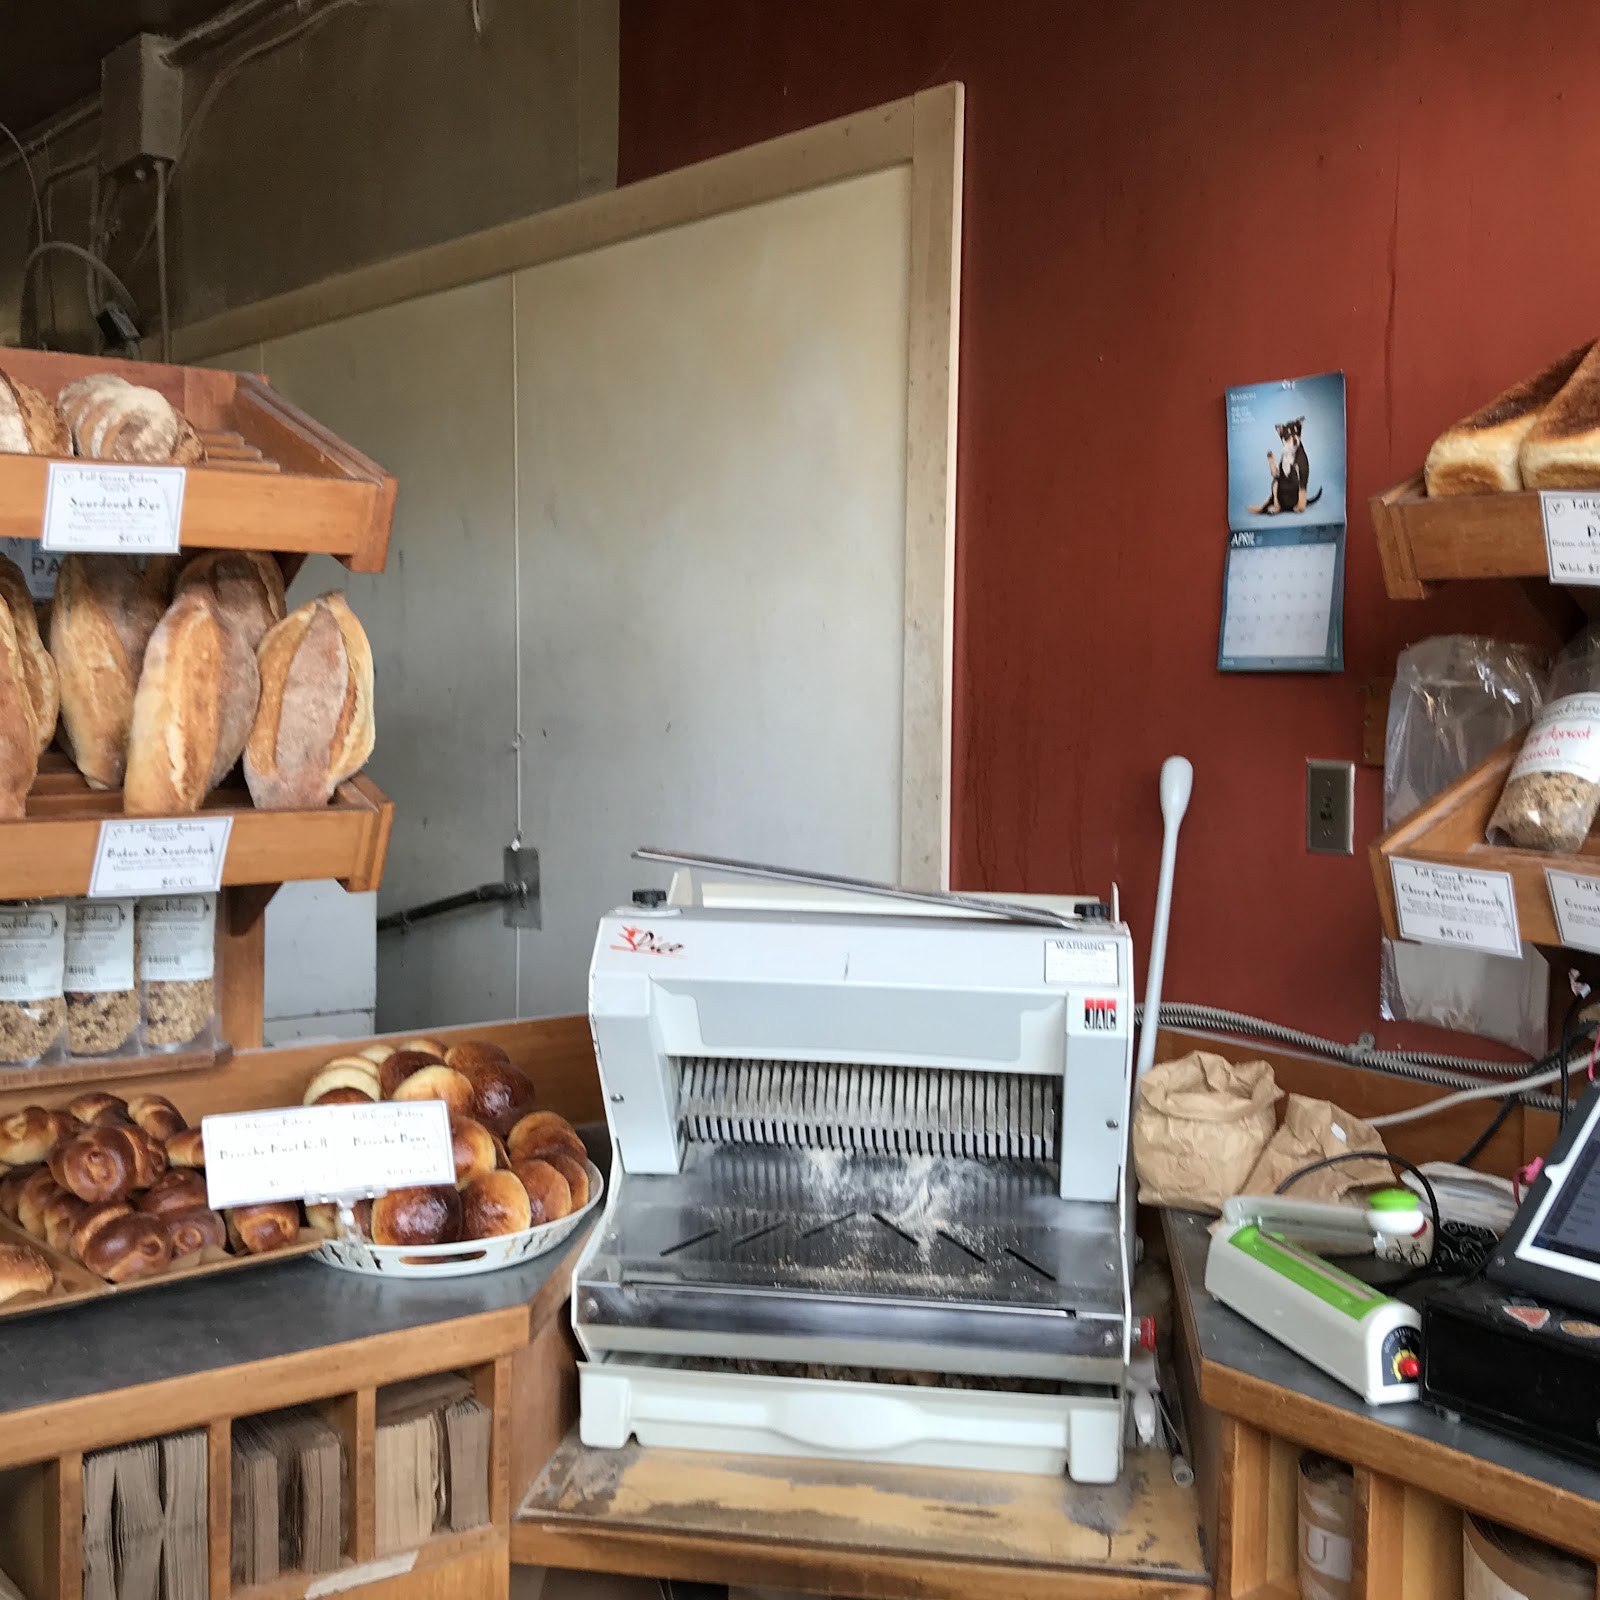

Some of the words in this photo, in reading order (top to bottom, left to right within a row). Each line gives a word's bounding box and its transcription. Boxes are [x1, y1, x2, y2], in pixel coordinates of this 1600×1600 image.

[69, 496, 133, 510] Sourdough
[138, 496, 160, 511] Rye
[1572, 498, 1589, 510] Tall
[1412, 866, 1429, 877] Tall
[1431, 869, 1456, 880] Grass
[1458, 872, 1488, 887] Bakery
[1574, 879, 1592, 891] Tall
[1401, 882, 1430, 899] Cherry
[1433, 888, 1465, 902] Apricot
[1467, 892, 1505, 908] Granola
[1439, 925, 1474, 940] $8.00
[1055, 940, 1106, 950] WARNING
[1084, 1007, 1117, 1031] JAC
